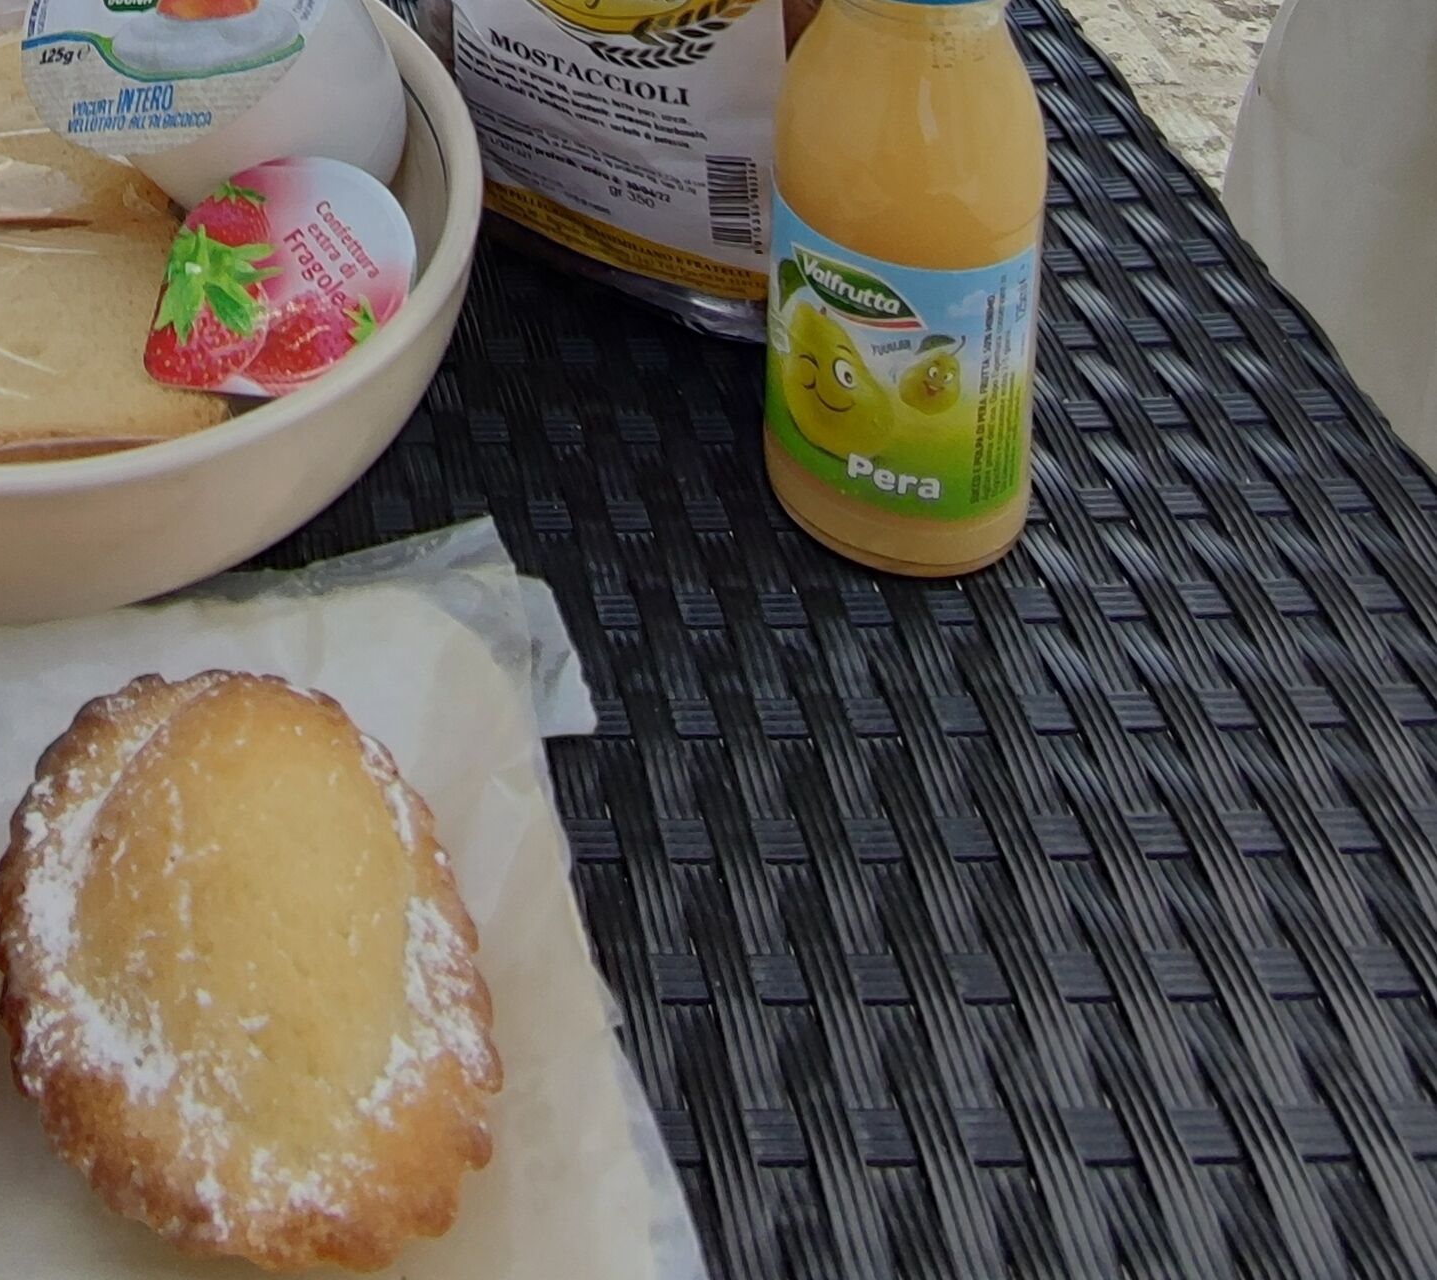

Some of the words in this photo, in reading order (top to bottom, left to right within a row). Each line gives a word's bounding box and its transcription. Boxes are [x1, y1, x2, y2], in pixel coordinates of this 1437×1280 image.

[39, 47, 74, 65] 125g
[489, 27, 691, 107] MOSTACCIOLI
[116, 84, 175, 114] INTERO
[628, 190, 657, 209] 350
[283, 228, 347, 306] Fragole
[307, 223, 341, 262] extra
[339, 262, 359, 280] di
[316, 200, 380, 279] Confettura
[801, 251, 902, 316] Valfrutta
[847, 452, 942, 501] Pera
